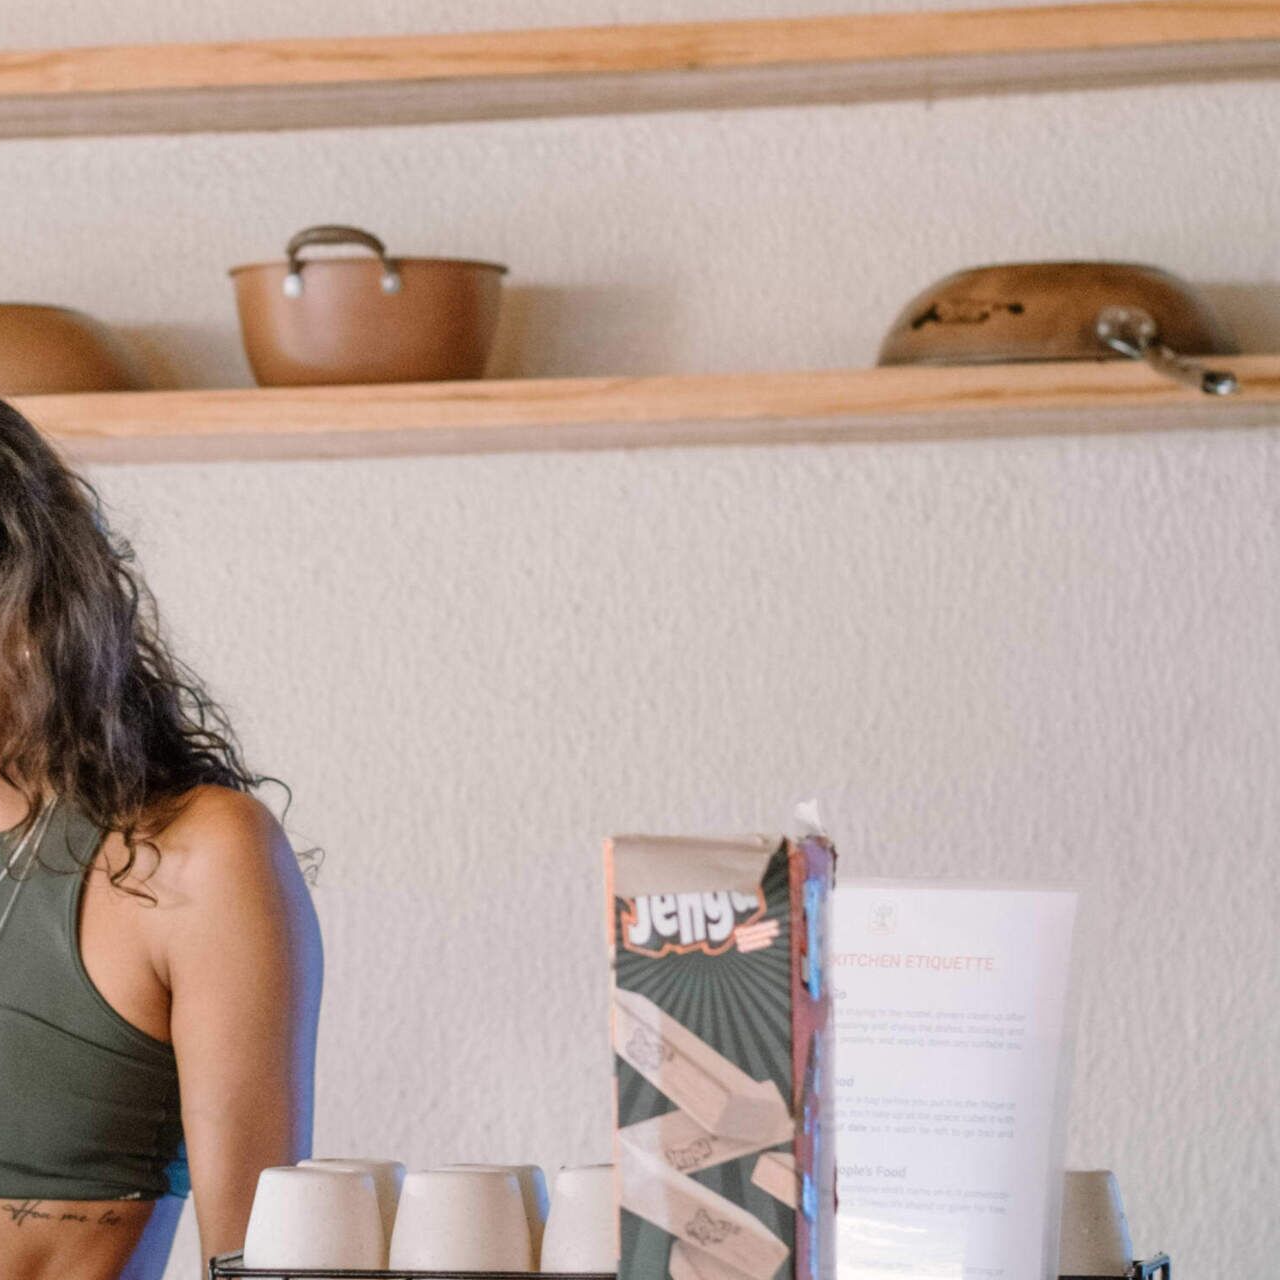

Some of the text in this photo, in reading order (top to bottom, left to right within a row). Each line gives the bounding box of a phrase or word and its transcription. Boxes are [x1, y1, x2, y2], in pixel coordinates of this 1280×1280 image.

[829, 952, 994, 971] KITCHEN ETIQUETTE
[876, 1165, 907, 1178] Food
